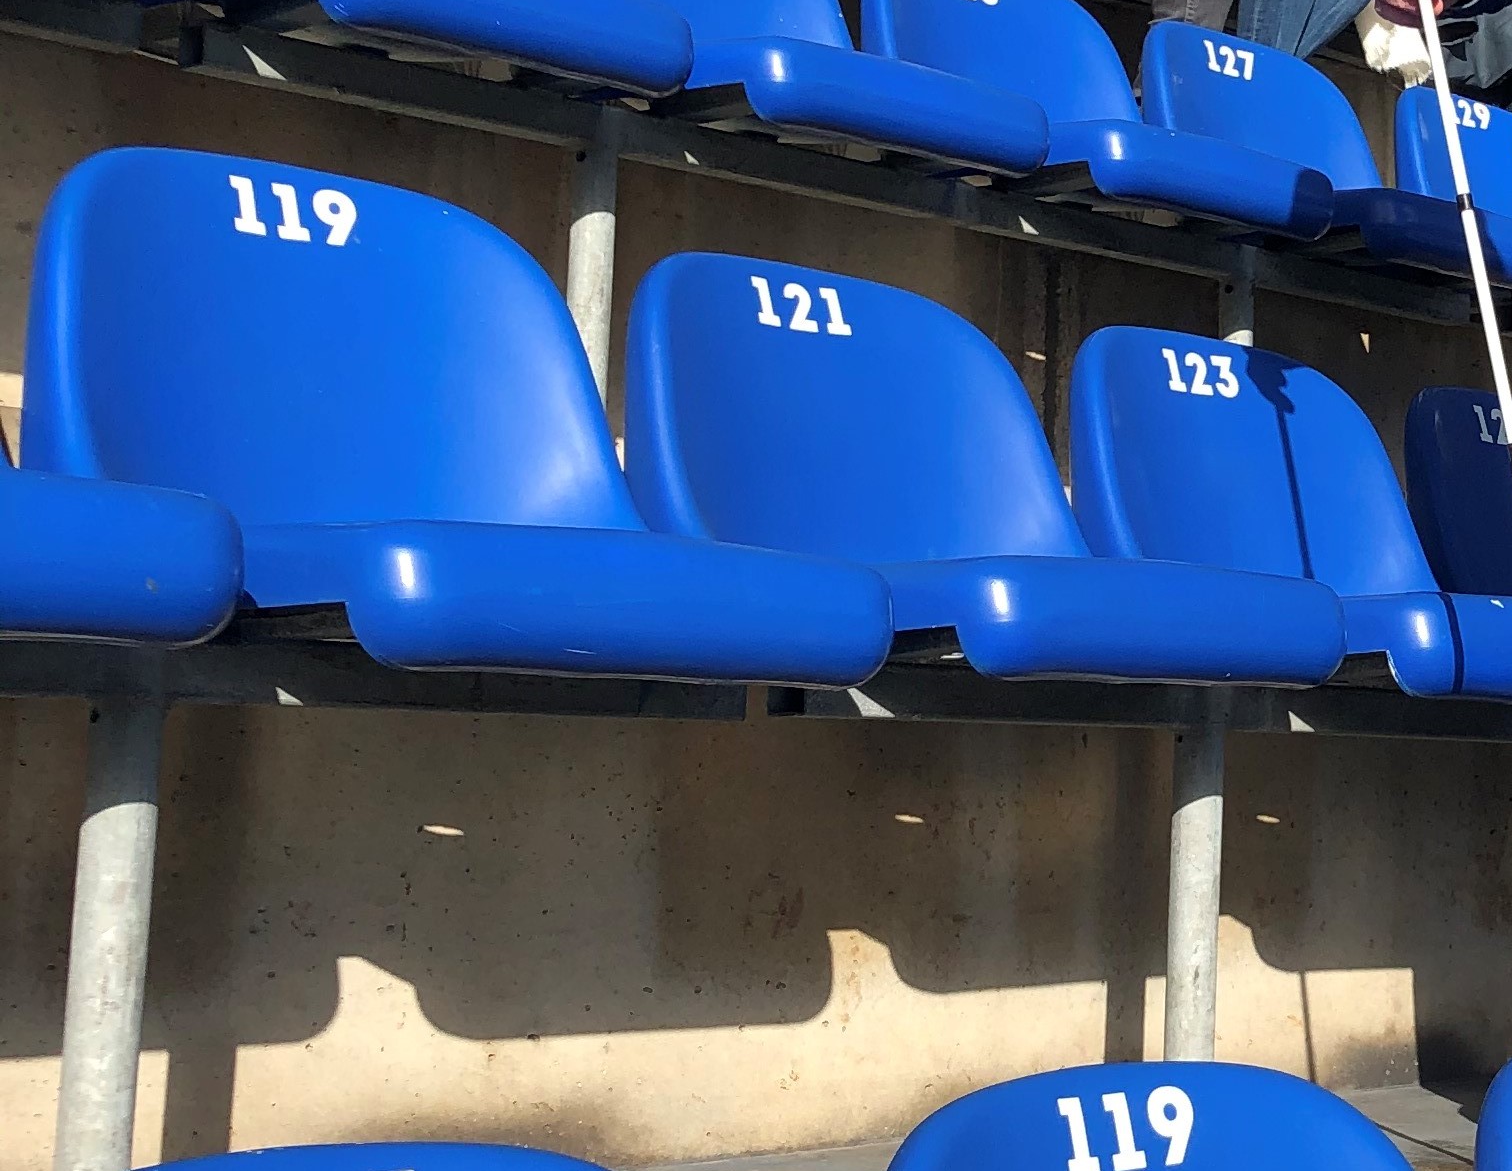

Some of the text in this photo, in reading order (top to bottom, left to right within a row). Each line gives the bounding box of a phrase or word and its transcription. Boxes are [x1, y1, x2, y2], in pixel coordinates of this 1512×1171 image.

[1203, 39, 1255, 81] 127
[229, 175, 356, 245] 119
[751, 276, 851, 335] 121
[1162, 349, 1239, 397] 123
[1057, 1086, 1193, 1171] 119
